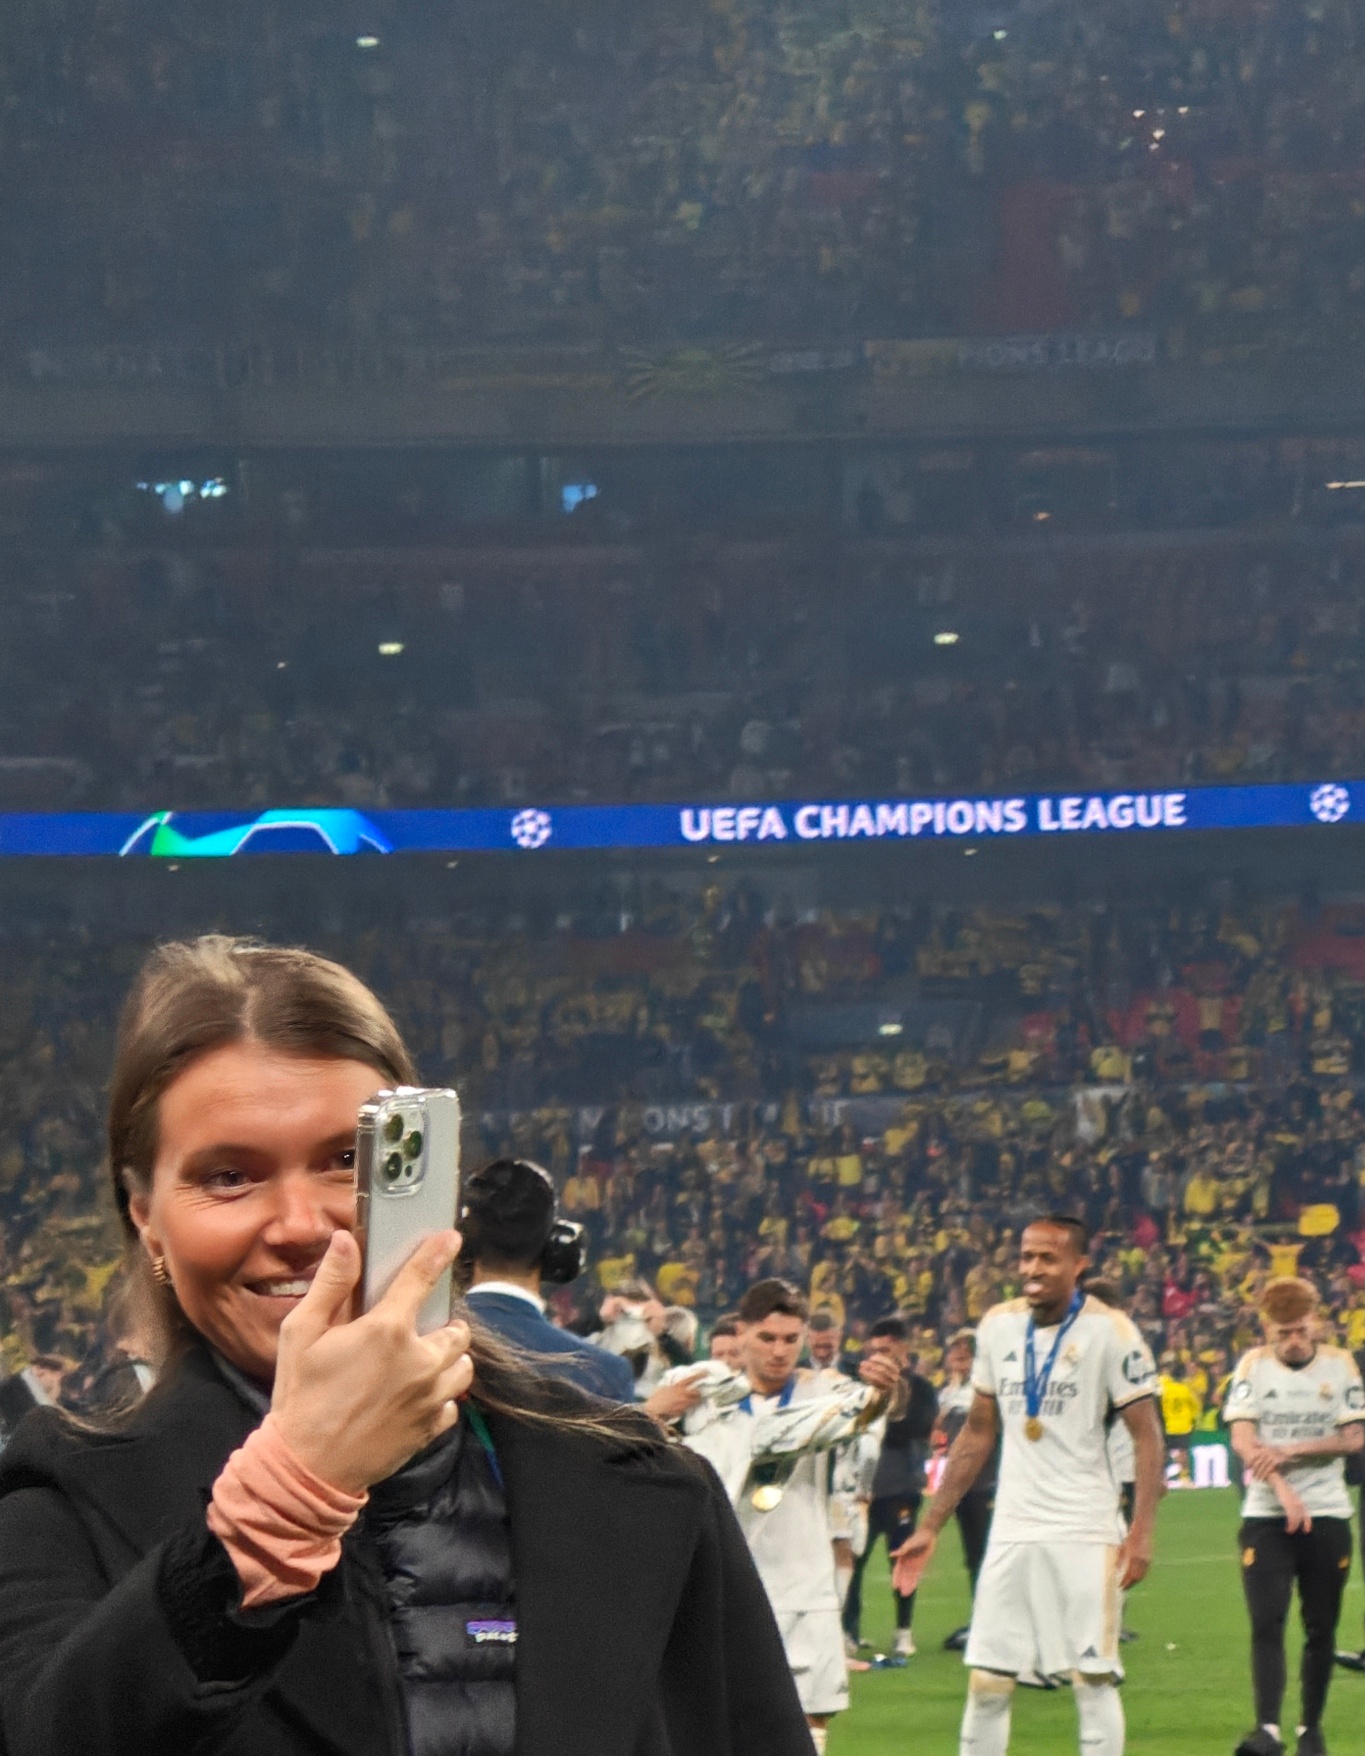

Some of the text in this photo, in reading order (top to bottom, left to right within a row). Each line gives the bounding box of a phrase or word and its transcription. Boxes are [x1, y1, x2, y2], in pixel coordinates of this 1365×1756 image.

[680, 793, 1187, 842] UEFA CHAMPIONS LEAGUE
